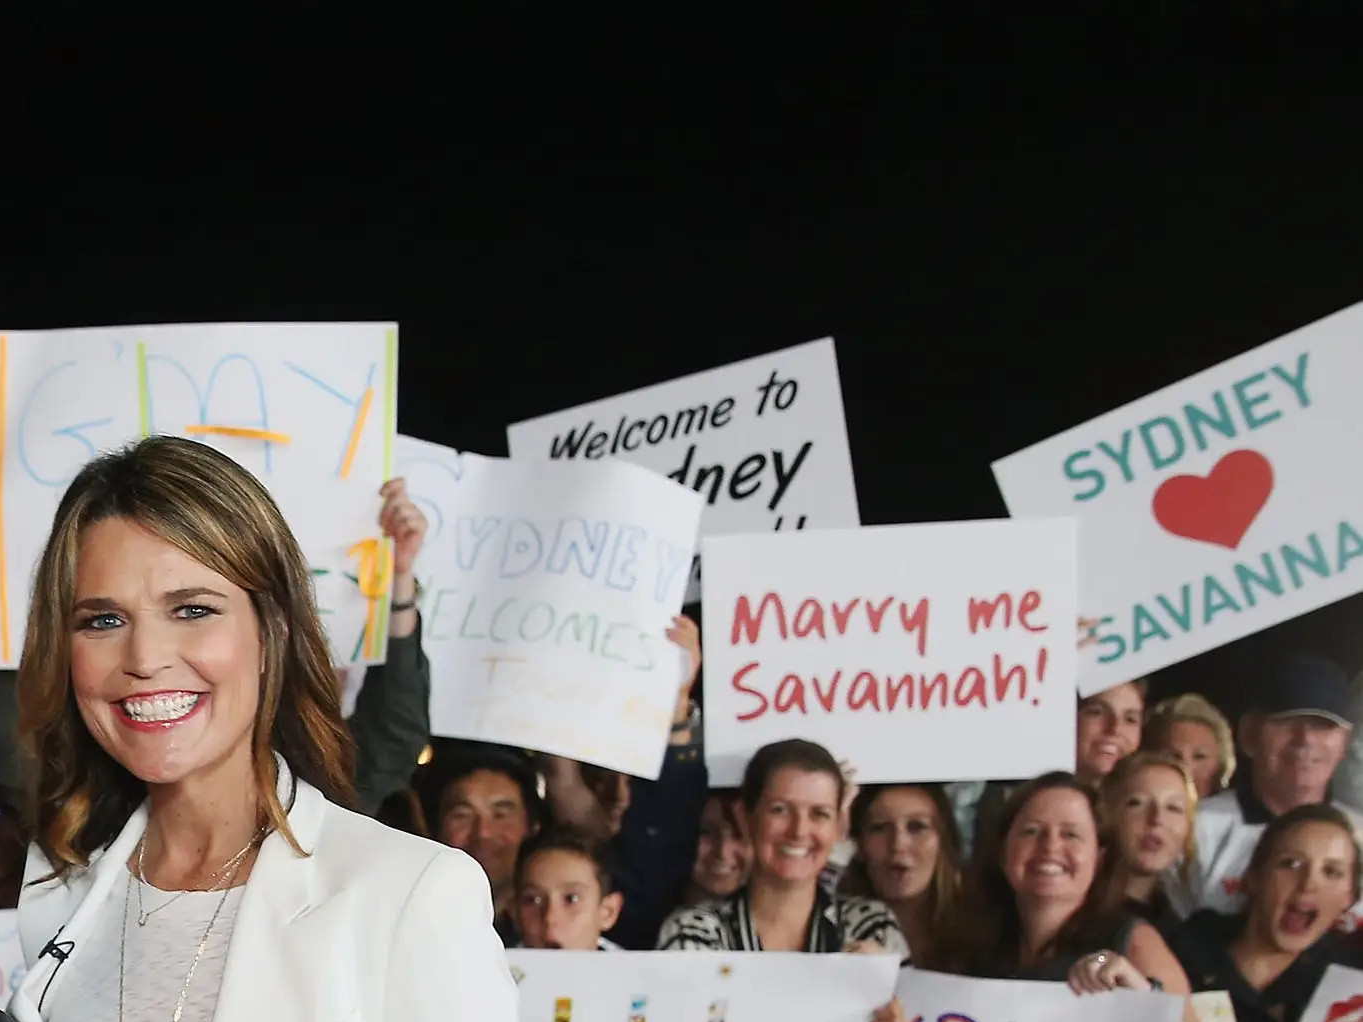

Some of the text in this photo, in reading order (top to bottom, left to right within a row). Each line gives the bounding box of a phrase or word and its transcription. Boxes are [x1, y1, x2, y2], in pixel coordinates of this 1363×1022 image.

[549, 369, 799, 461] Welcome to
[1061, 352, 1312, 503] SYDNEY
[416, 576, 658, 672] ELCOMES
[730, 589, 1049, 657] Marry me
[730, 647, 1049, 723] Savannah!
